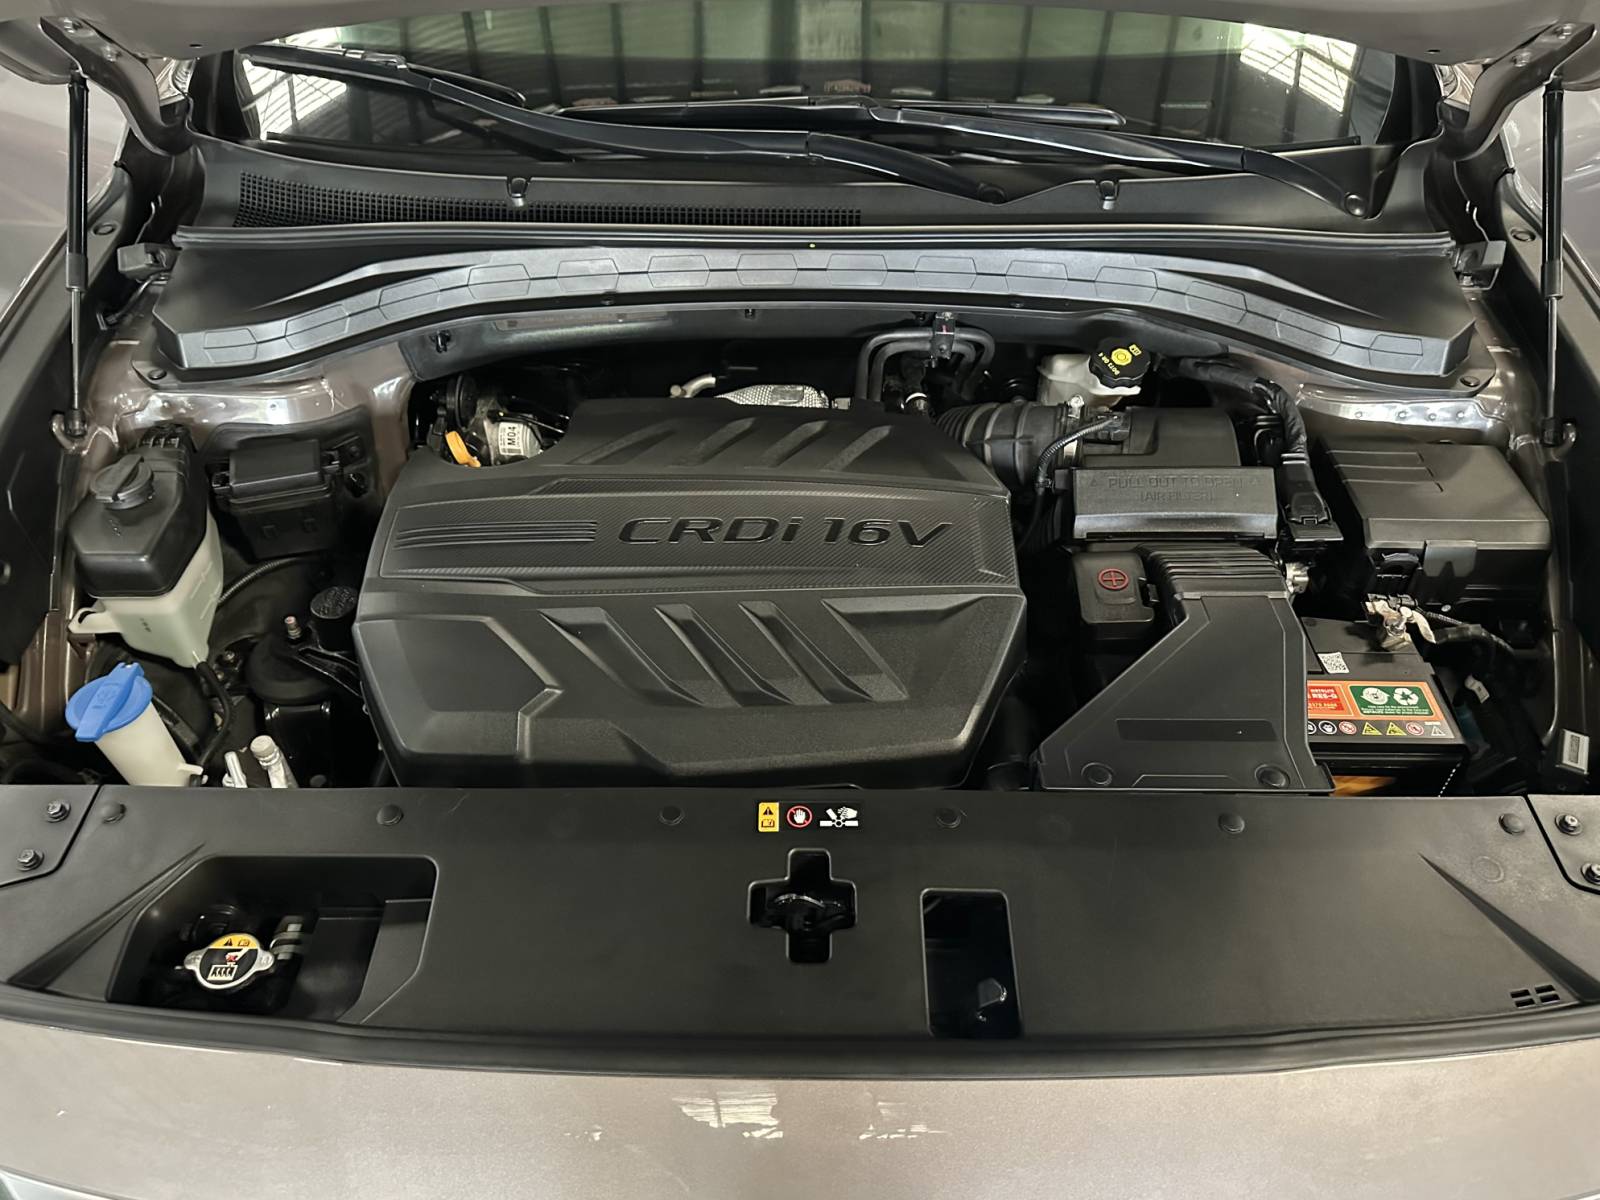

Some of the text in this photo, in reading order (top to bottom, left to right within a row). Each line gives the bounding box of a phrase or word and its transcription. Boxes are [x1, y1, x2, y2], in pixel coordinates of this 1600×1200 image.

[1108, 475, 1243, 489] PULL OUT TO OPEN
[617, 516, 952, 548] CRDi 16V
